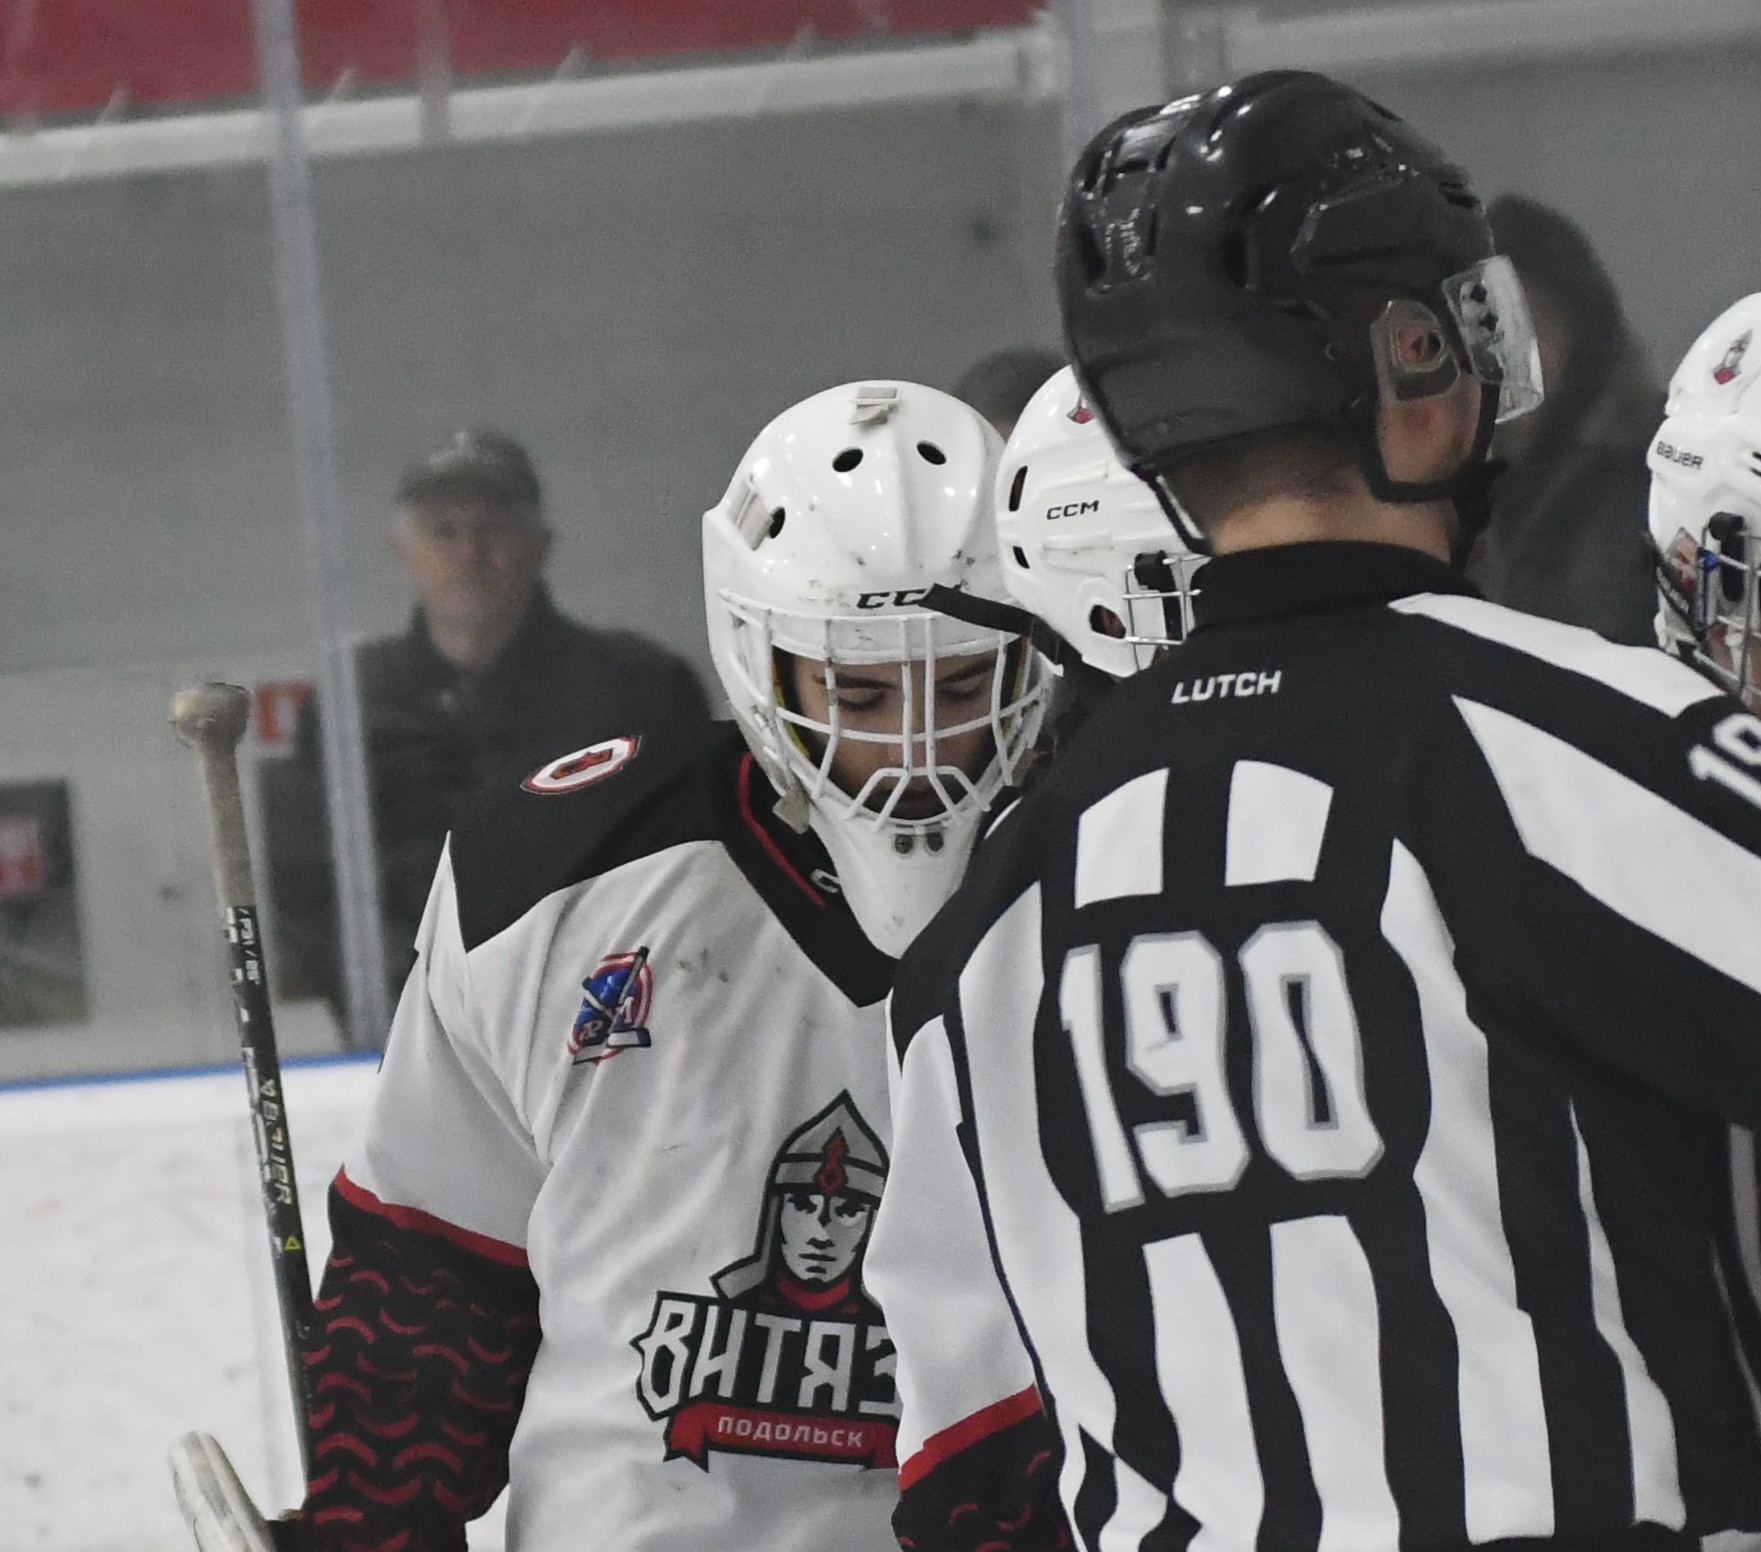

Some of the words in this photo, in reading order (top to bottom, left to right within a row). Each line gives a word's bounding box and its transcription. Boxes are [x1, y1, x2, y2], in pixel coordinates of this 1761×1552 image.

[1656, 440, 1704, 470] BAUER
[1045, 499, 1100, 520] CCM
[857, 586, 934, 609] CC
[1171, 670, 1282, 704] LUTCH
[1059, 920, 1385, 1214] 190
[638, 1298, 901, 1417] ВИТЯЗ
[716, 1415, 862, 1448] ПОДОЛЬСК
